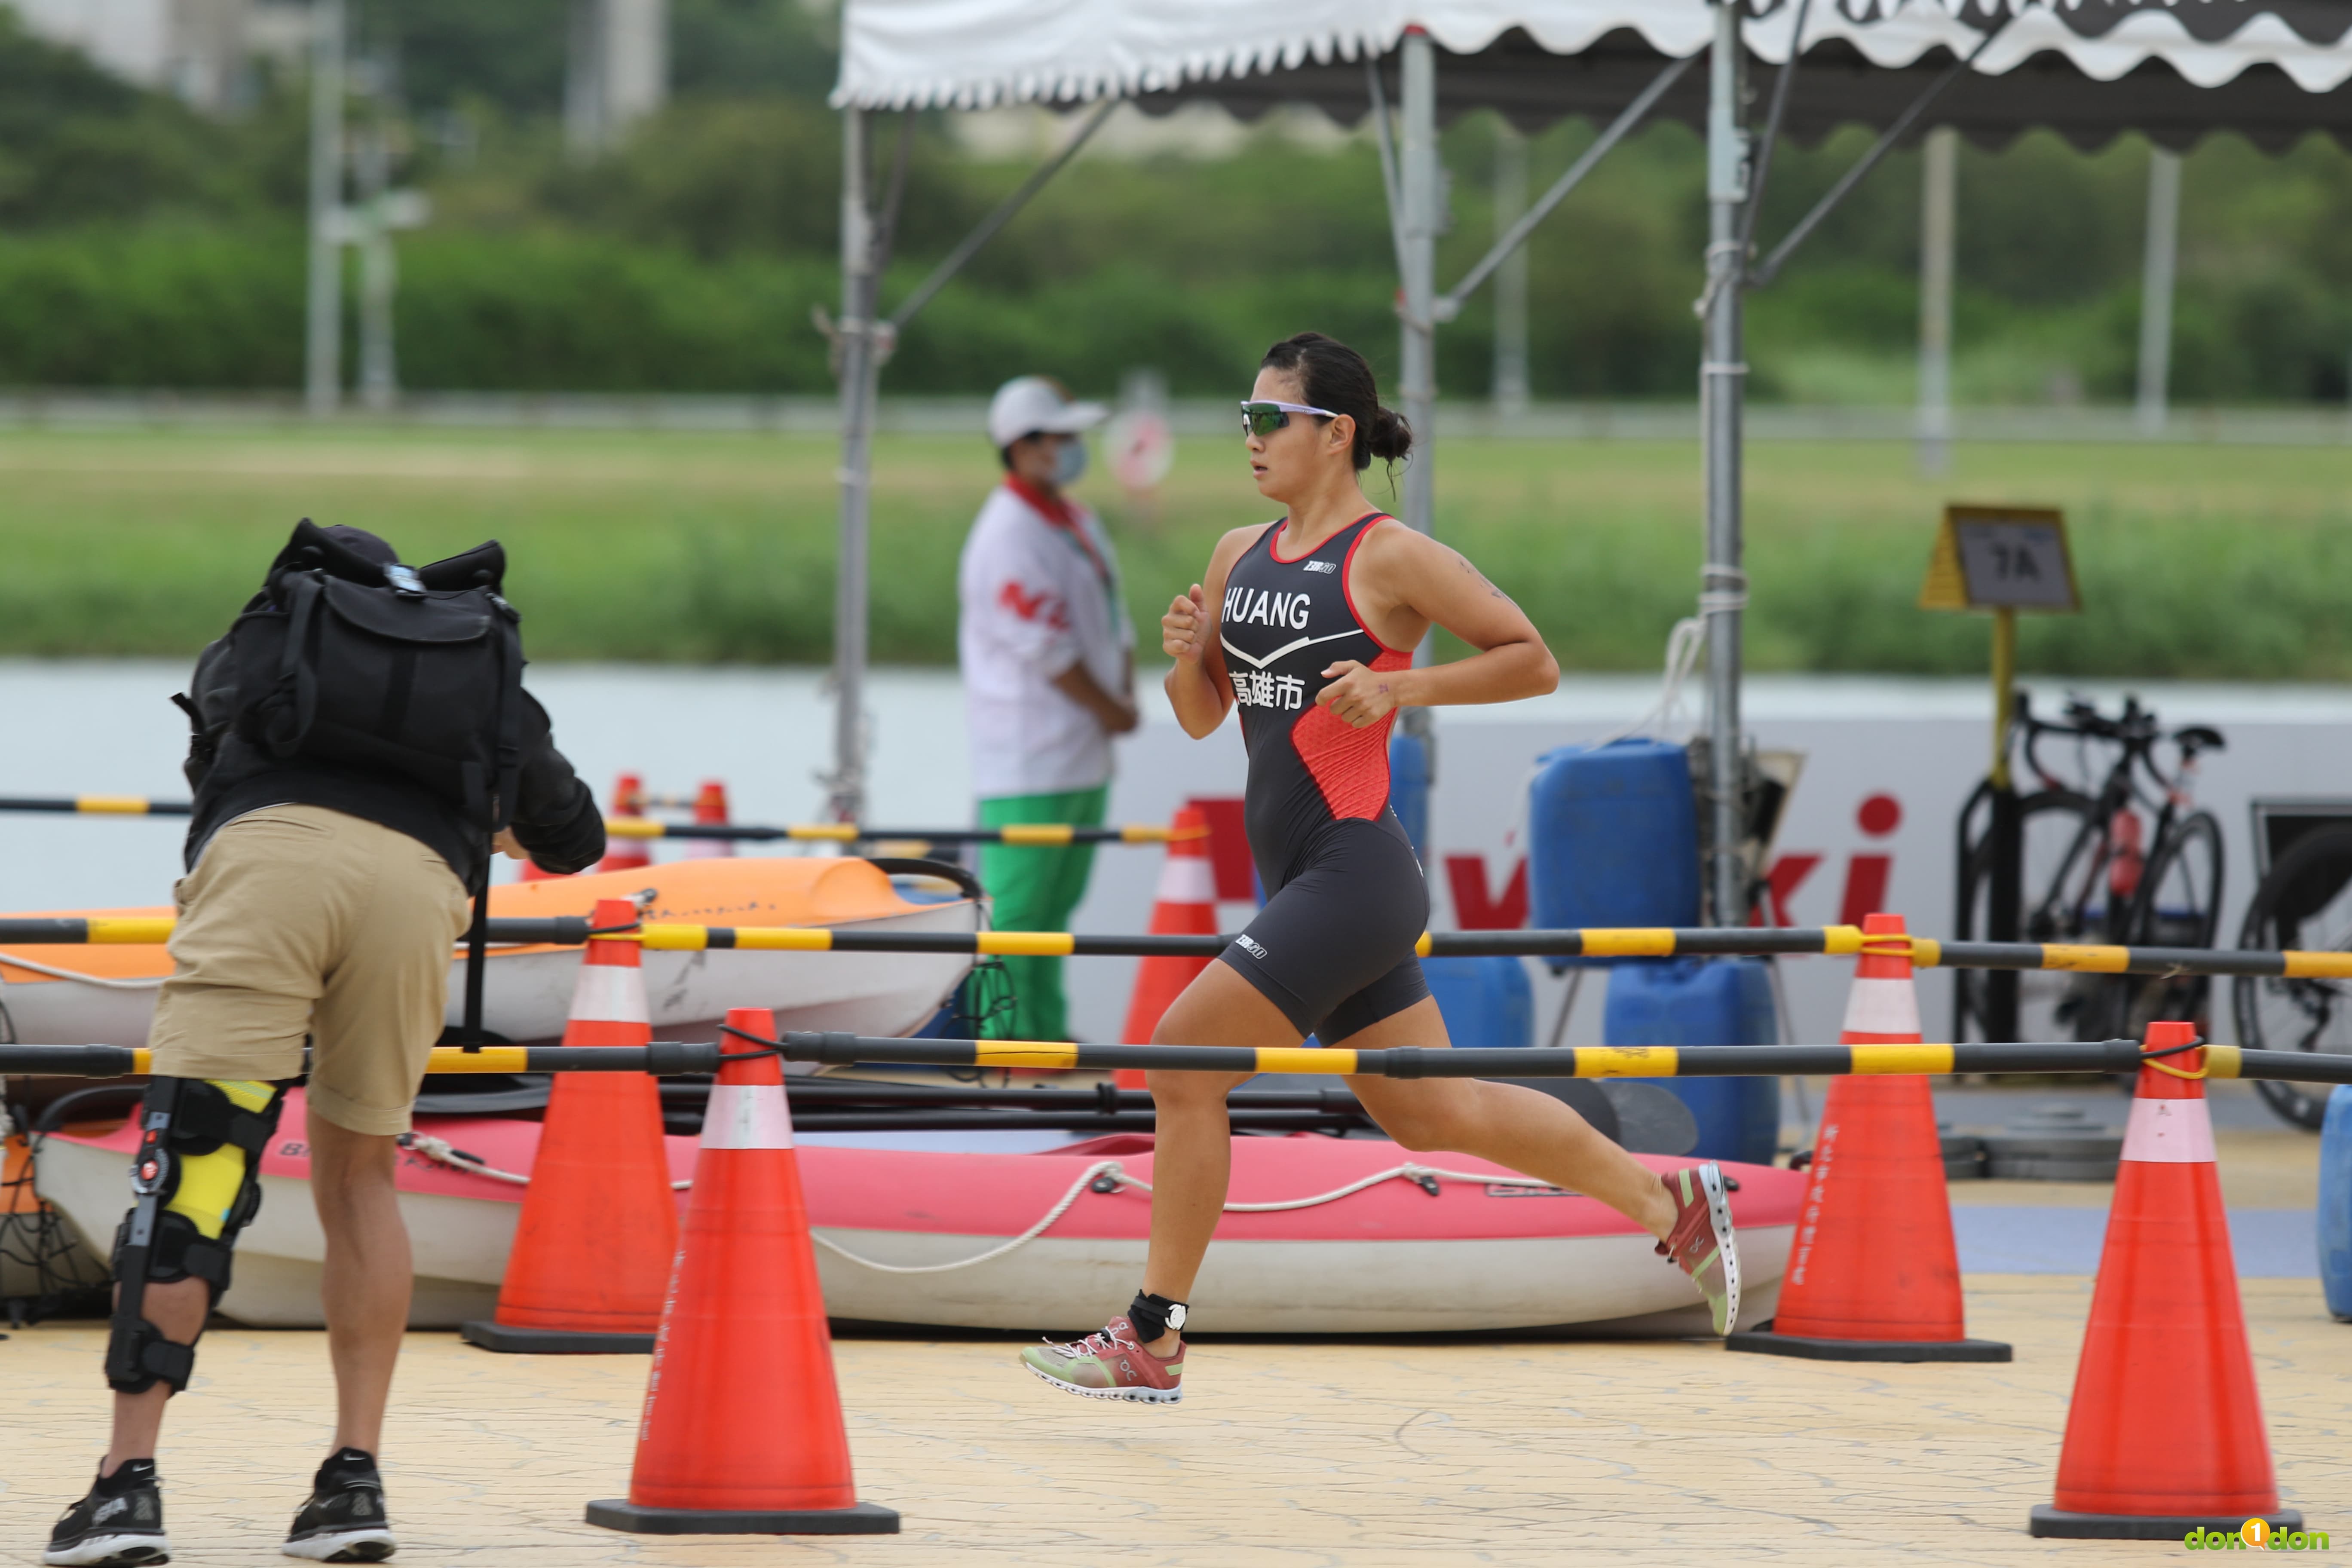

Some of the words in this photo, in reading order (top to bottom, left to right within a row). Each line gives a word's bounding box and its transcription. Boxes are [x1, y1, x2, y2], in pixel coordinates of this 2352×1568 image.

[1221, 587, 1311, 630] HUANG
[1228, 670, 1305, 711] 高雄市
